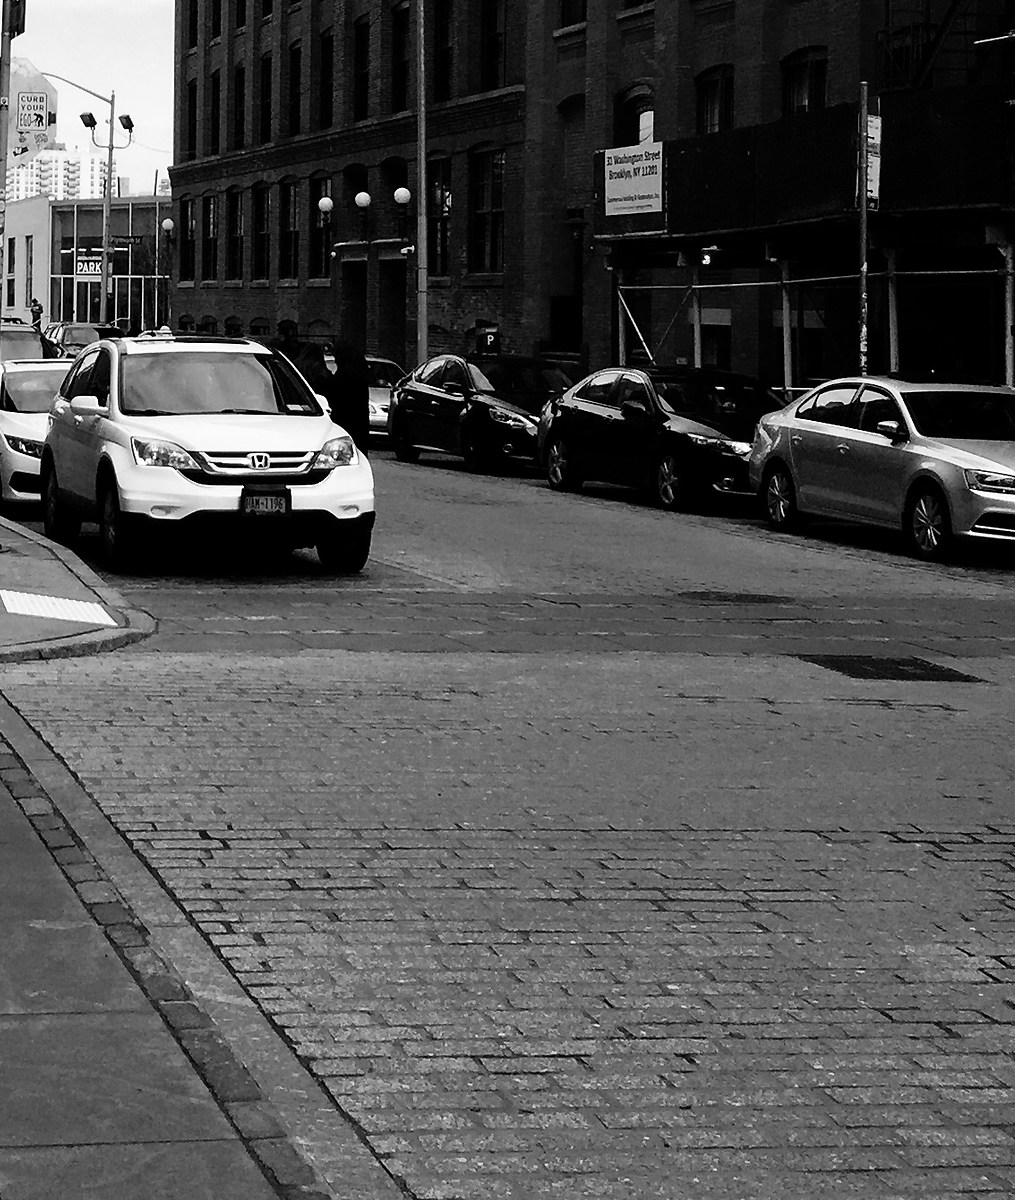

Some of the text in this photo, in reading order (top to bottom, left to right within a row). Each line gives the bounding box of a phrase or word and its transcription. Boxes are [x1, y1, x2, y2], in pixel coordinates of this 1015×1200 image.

[21, 95, 45, 103] CURB
[77, 261, 102, 274] PARK
[487, 334, 495, 346] P
